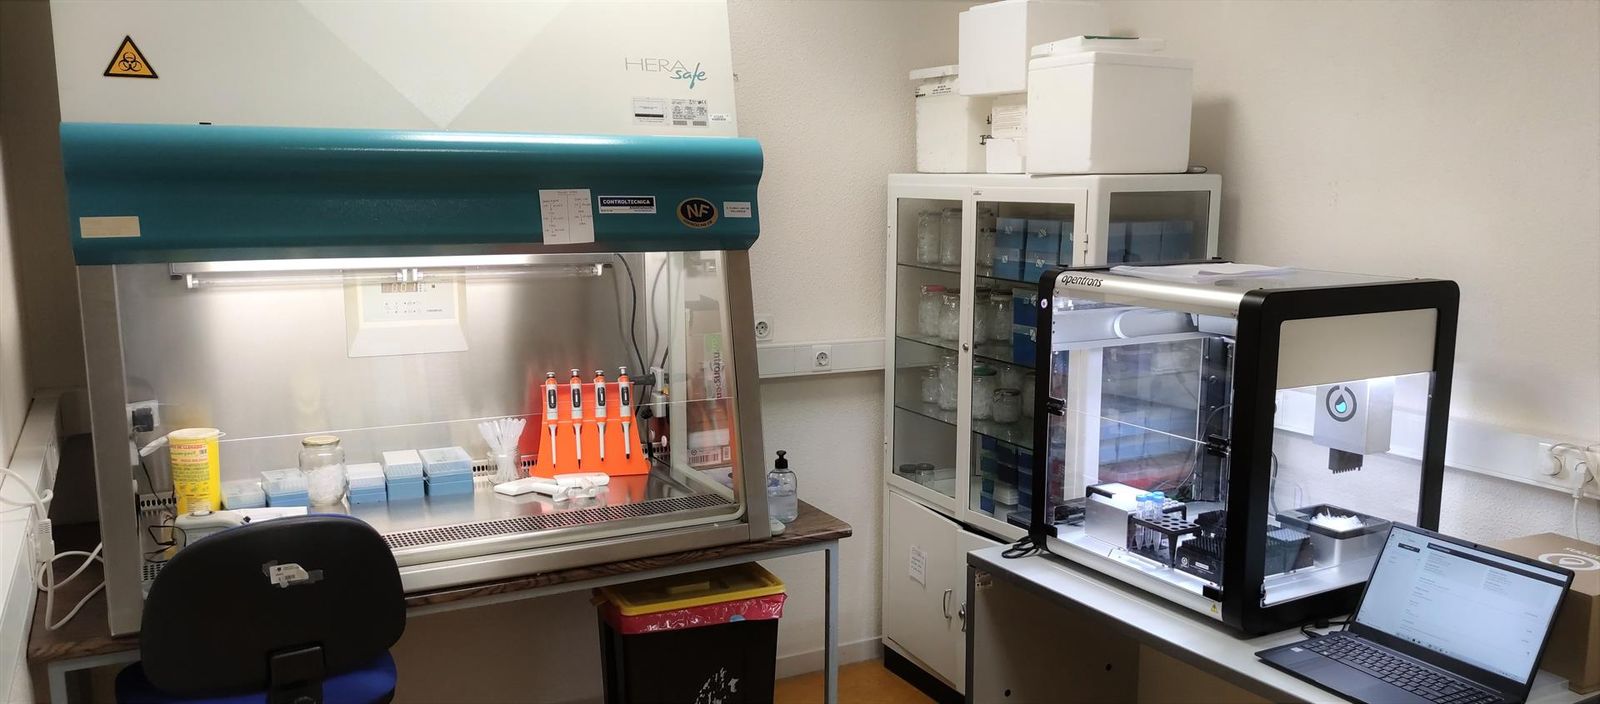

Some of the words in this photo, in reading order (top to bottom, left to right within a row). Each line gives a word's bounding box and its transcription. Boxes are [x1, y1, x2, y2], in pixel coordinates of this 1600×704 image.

[624, 56, 689, 73] HERA
[670, 62, 708, 89] safe
[686, 203, 710, 219] NF
[1061, 275, 1103, 287] opentrons
